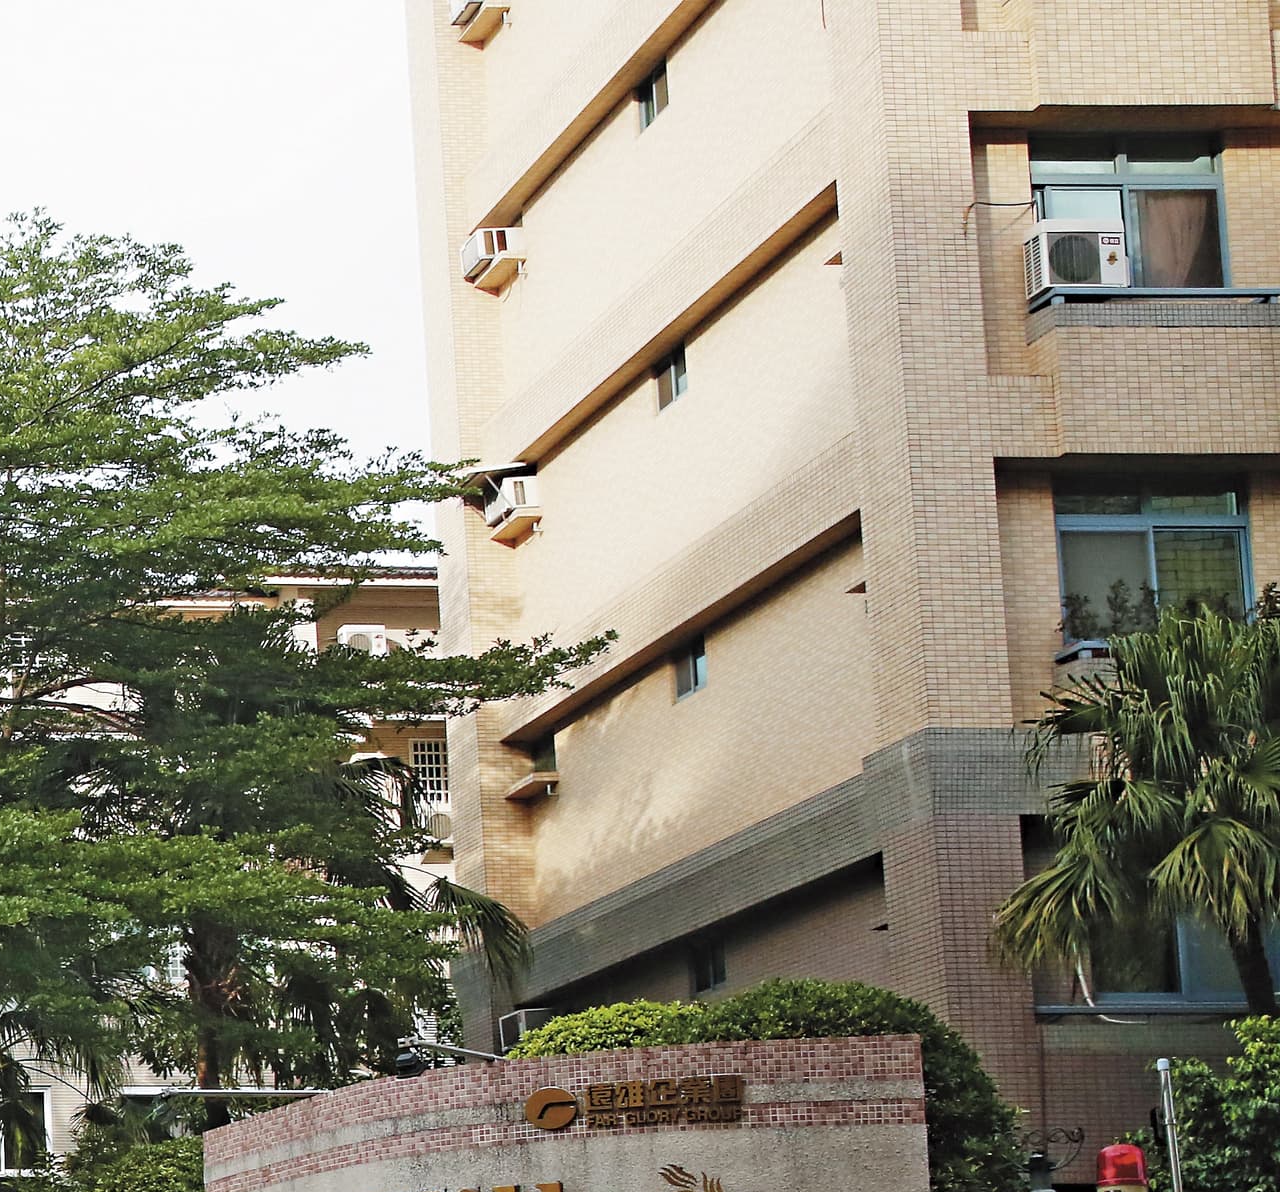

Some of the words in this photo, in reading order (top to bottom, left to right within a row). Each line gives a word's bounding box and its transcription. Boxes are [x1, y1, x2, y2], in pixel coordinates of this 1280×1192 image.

[587, 1075, 744, 1112] 遠雄企業團
[587, 1112, 618, 1127] FAR
[625, 1109, 681, 1126] GLORY
[686, 1107, 743, 1122] GROUP
